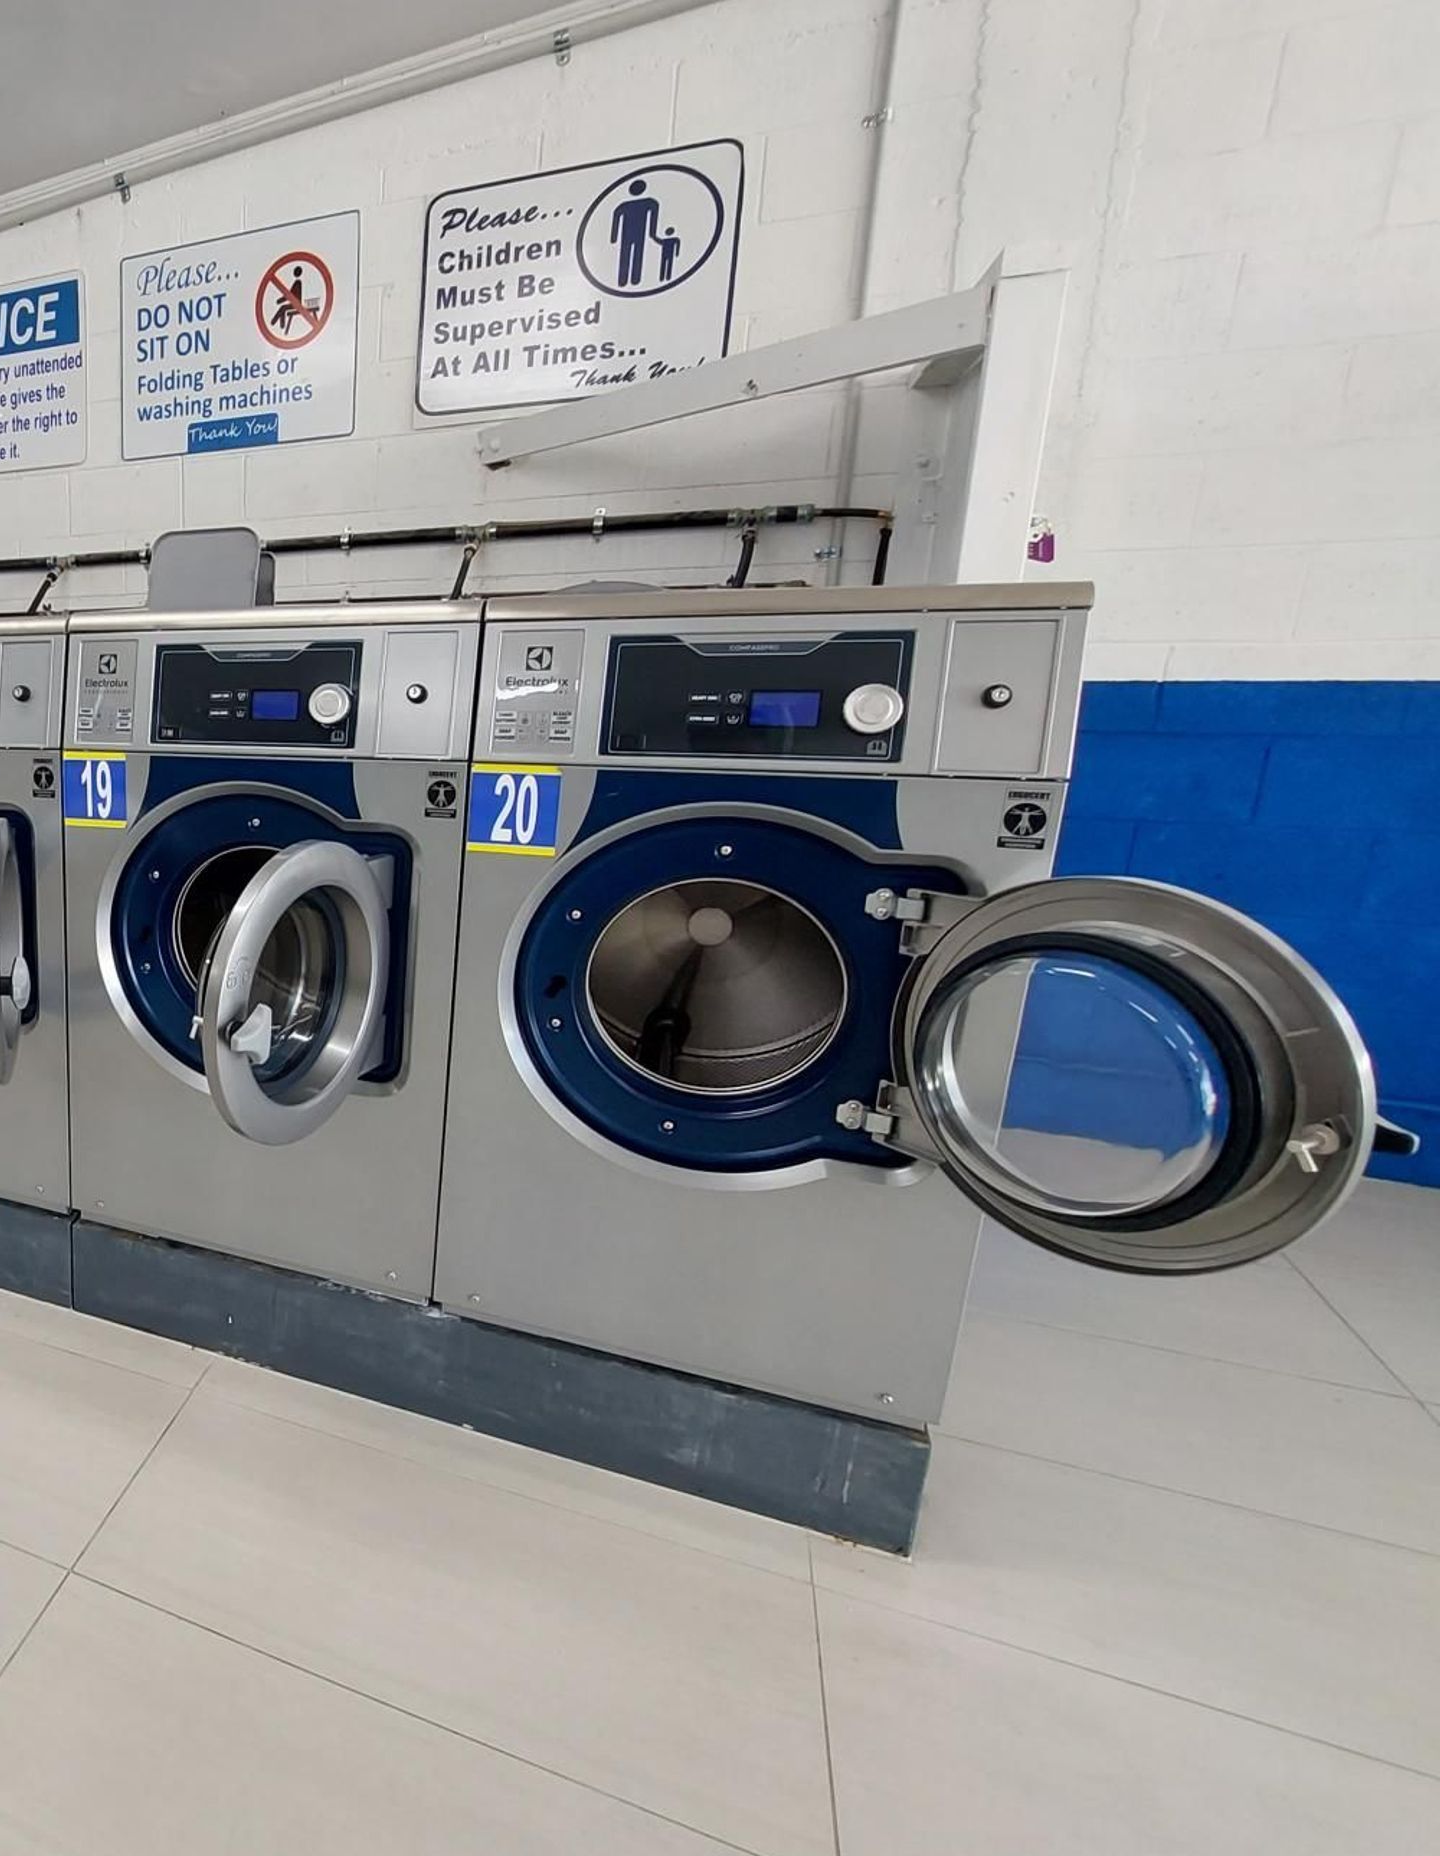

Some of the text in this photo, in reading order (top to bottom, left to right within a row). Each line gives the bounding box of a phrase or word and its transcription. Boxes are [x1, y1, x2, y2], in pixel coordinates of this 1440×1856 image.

[438, 238, 562, 275] Children
[436, 273, 556, 310] Must Be
[138, 293, 227, 331] DO NOT
[433, 301, 601, 346] Supervised
[14, 350, 82, 377] unattended
[137, 328, 210, 363] SIT ON
[430, 341, 646, 379] At All Times...
[138, 356, 298, 395] Folding Tables or
[570, 365, 637, 389] Thank
[10, 388, 42, 408] gives
[46, 383, 66, 400] the
[137, 383, 313, 422] washing machines
[12, 415, 30, 432] the
[34, 412, 62, 433] right
[65, 409, 78, 425] to
[188, 416, 278, 443] Thank You!
[85, 678, 128, 688] Electrolux
[81, 760, 113, 819] 19
[493, 774, 539, 845] 20
